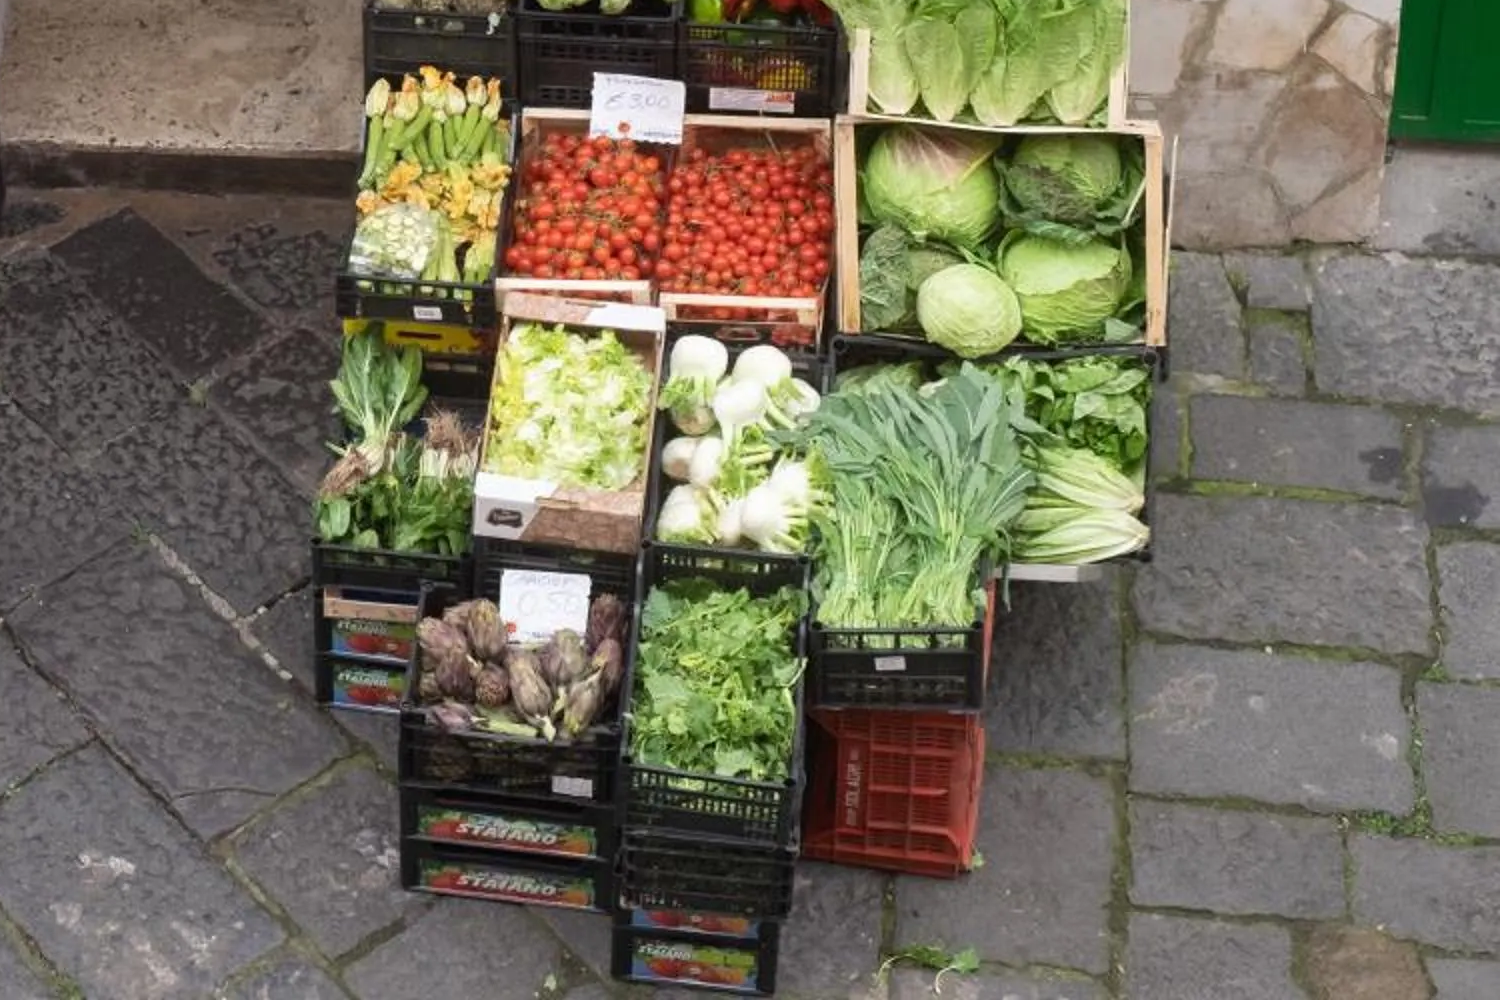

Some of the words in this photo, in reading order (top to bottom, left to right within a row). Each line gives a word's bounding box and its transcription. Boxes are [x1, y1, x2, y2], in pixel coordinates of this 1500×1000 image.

[456, 822, 558, 846] STAIANO
[456, 874, 557, 896] STAIANO
[638, 944, 692, 961] STAIANO
